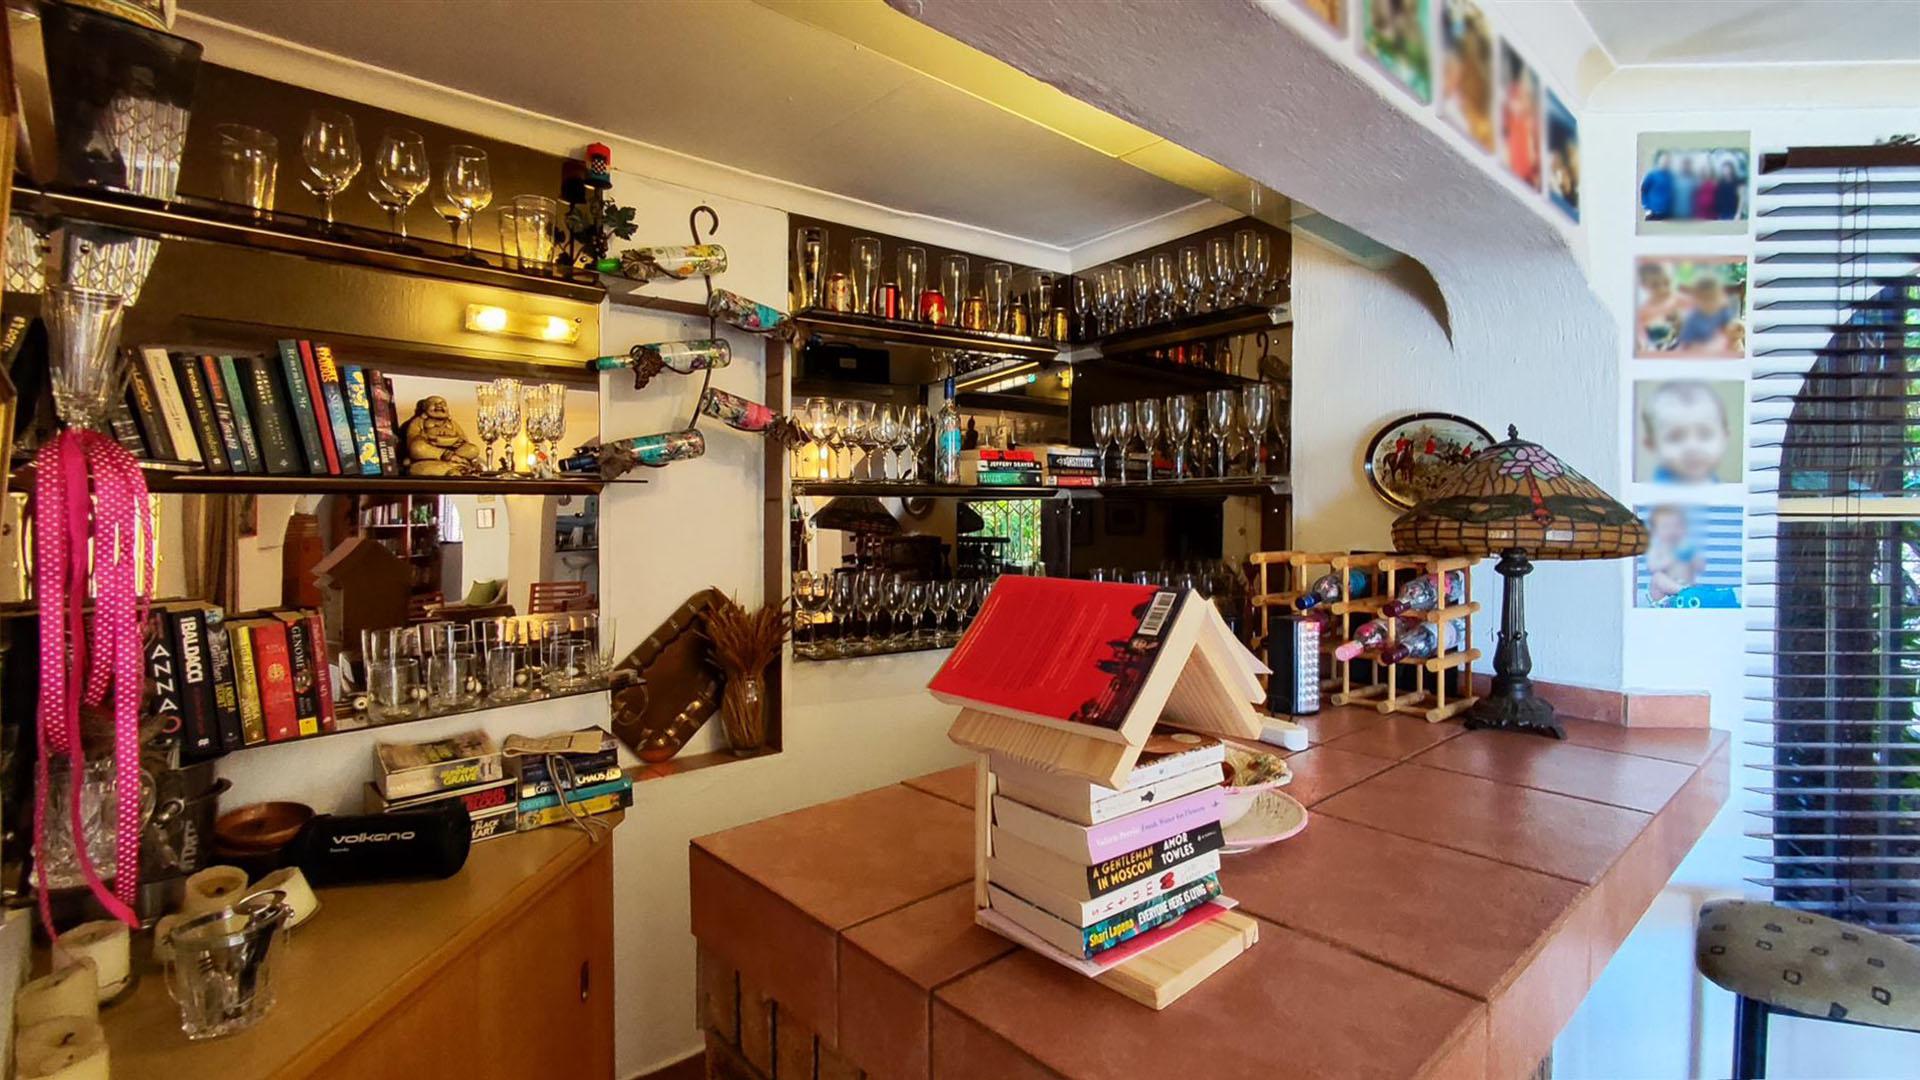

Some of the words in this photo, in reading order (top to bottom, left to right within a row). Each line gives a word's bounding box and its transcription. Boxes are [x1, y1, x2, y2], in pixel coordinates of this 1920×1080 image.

[286, 348, 302, 393] Remember
[291, 626, 305, 670] GENOME
[151, 643, 179, 714] ANNA
[443, 772, 478, 786] GRAVE
[333, 831, 417, 845] volkano
[1163, 832, 1189, 850] AMOR
[1093, 866, 1099, 878] A
[1102, 847, 1154, 875] GENTLEMAN
[1161, 843, 1195, 865] TOWLES
[1098, 876, 1109, 891] IN
[1111, 858, 1153, 886] MOSCOW
[1137, 902, 1168, 925] EVERYONE
[1168, 894, 1183, 912] HERE
[1089, 928, 1109, 947] Shari
